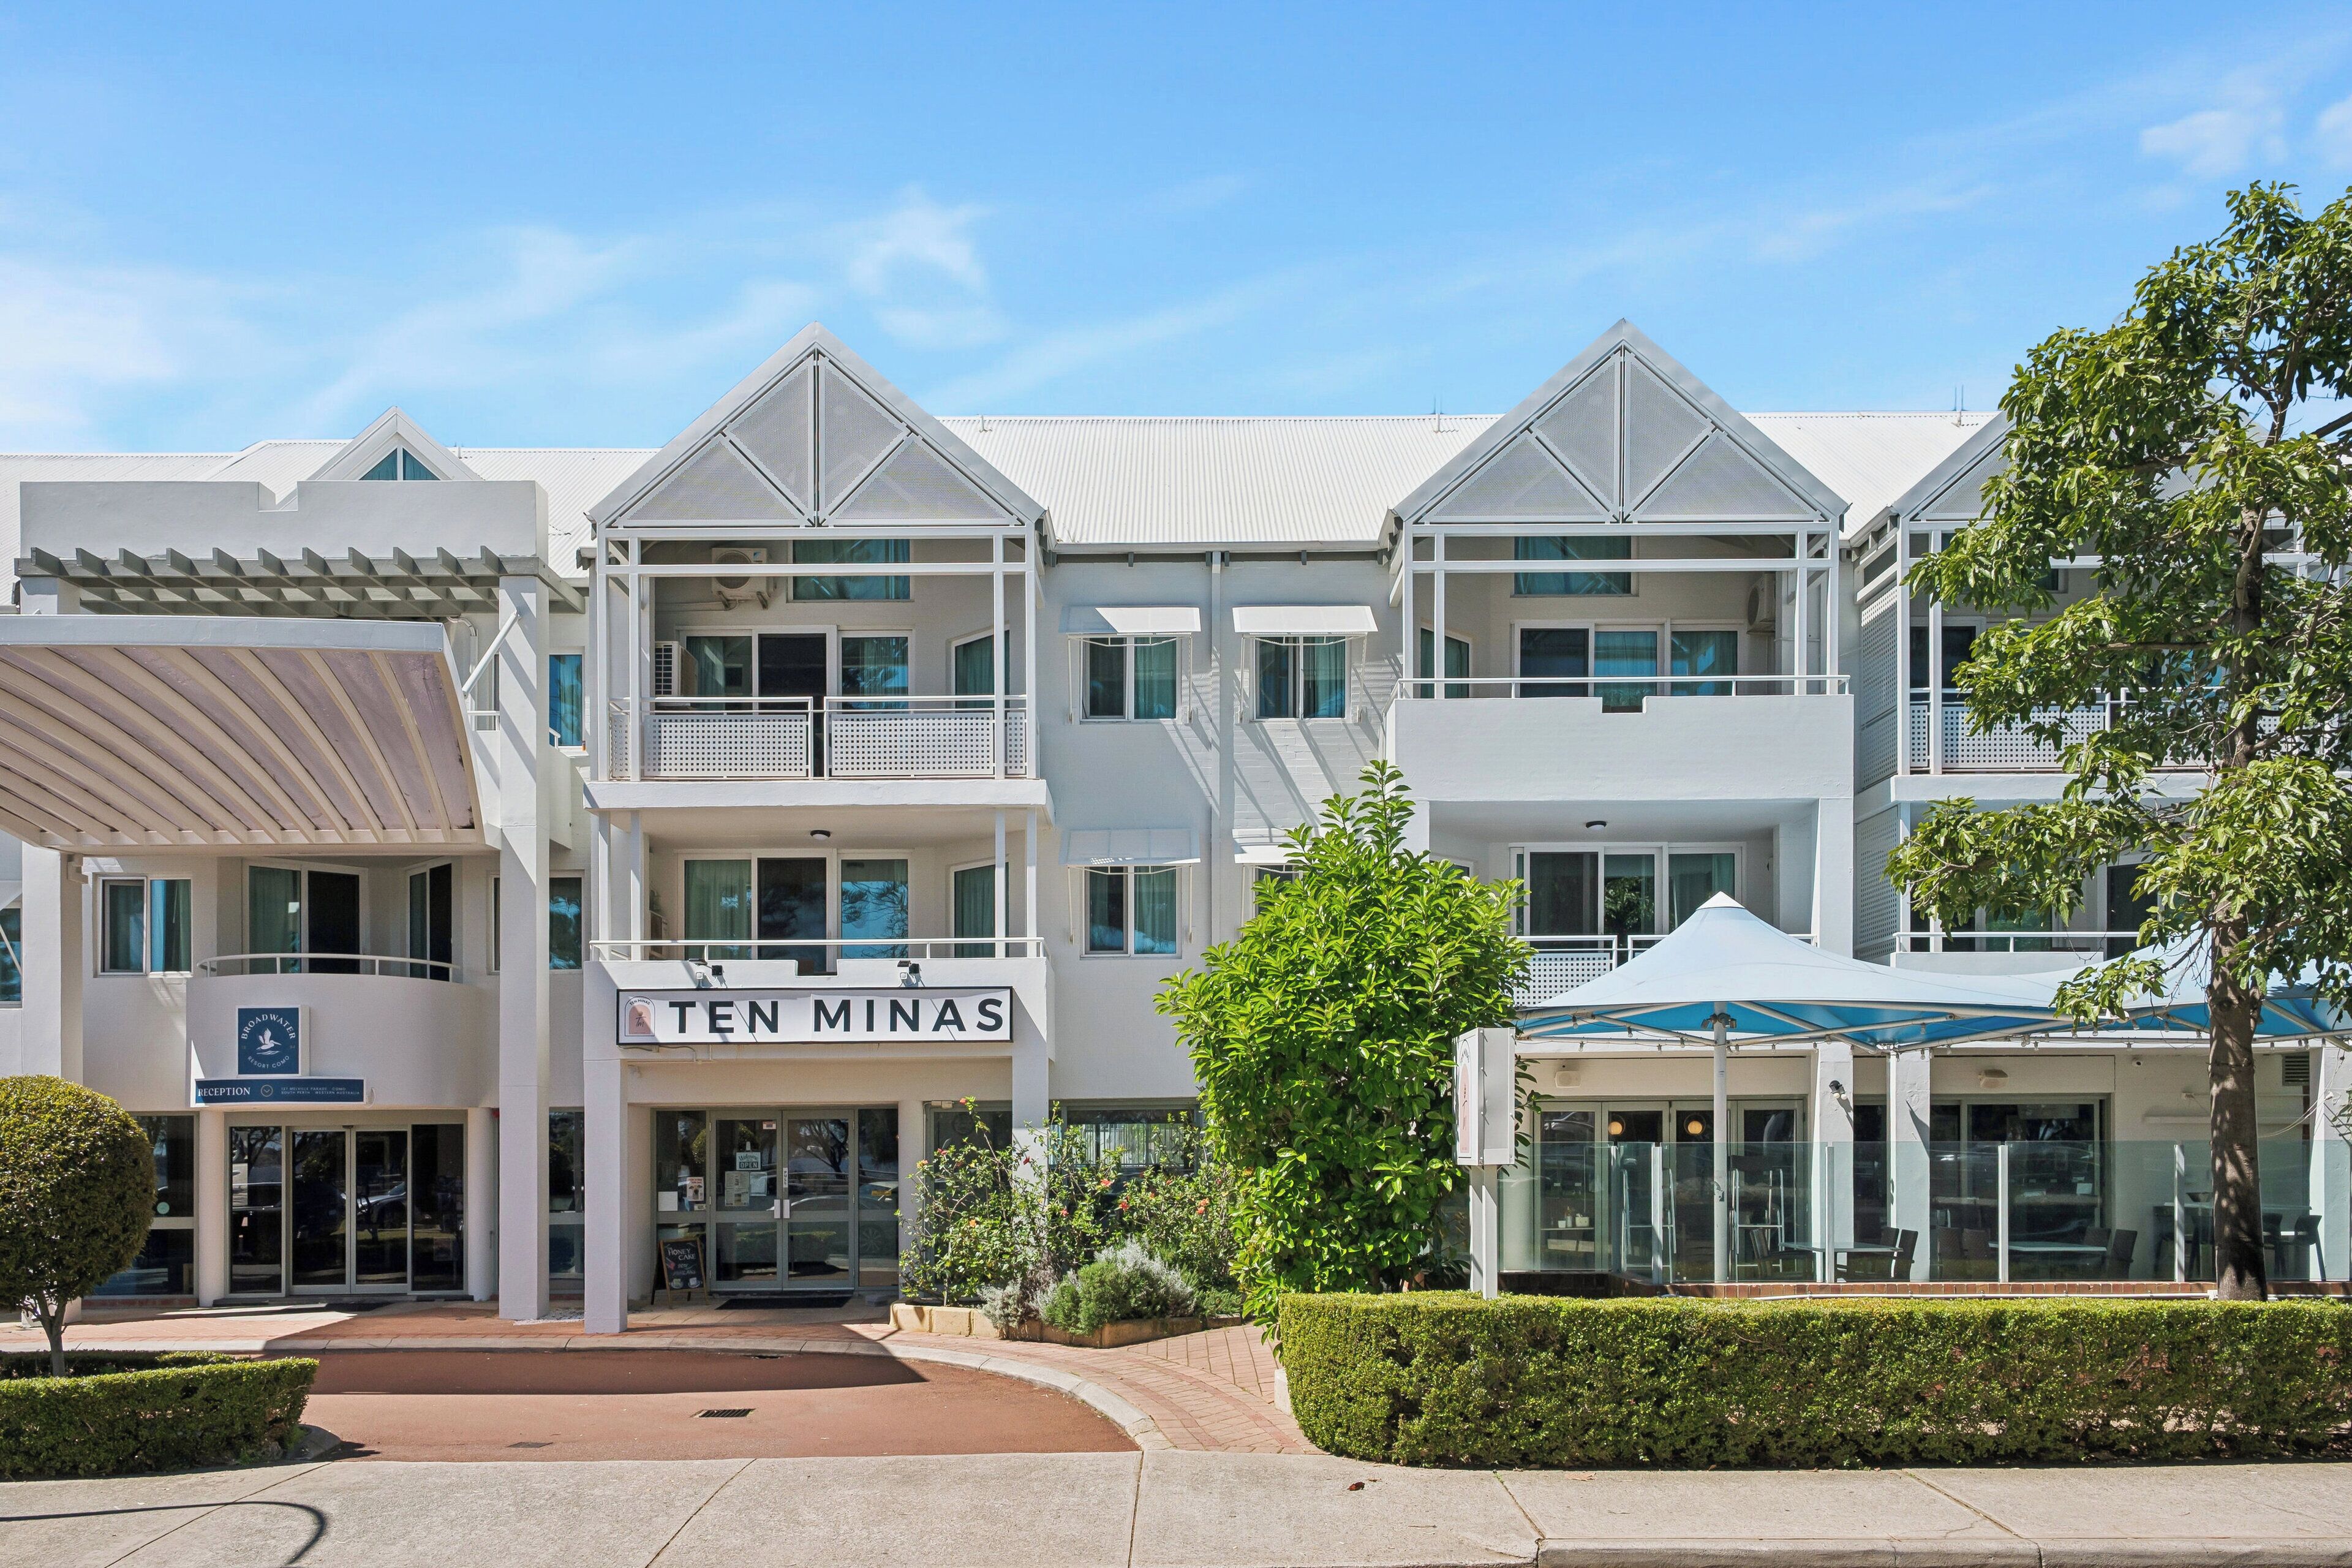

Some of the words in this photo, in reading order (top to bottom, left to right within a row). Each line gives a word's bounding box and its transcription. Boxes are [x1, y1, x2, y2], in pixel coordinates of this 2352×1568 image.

[668, 1000, 779, 1034] TEN
[813, 998, 1004, 1033] MINAS
[241, 1014, 296, 1039] BROADWATER
[247, 1055, 269, 1069] RESORT
[271, 1055, 290, 1068] COMO
[198, 1087, 251, 1096] RECEPTION
